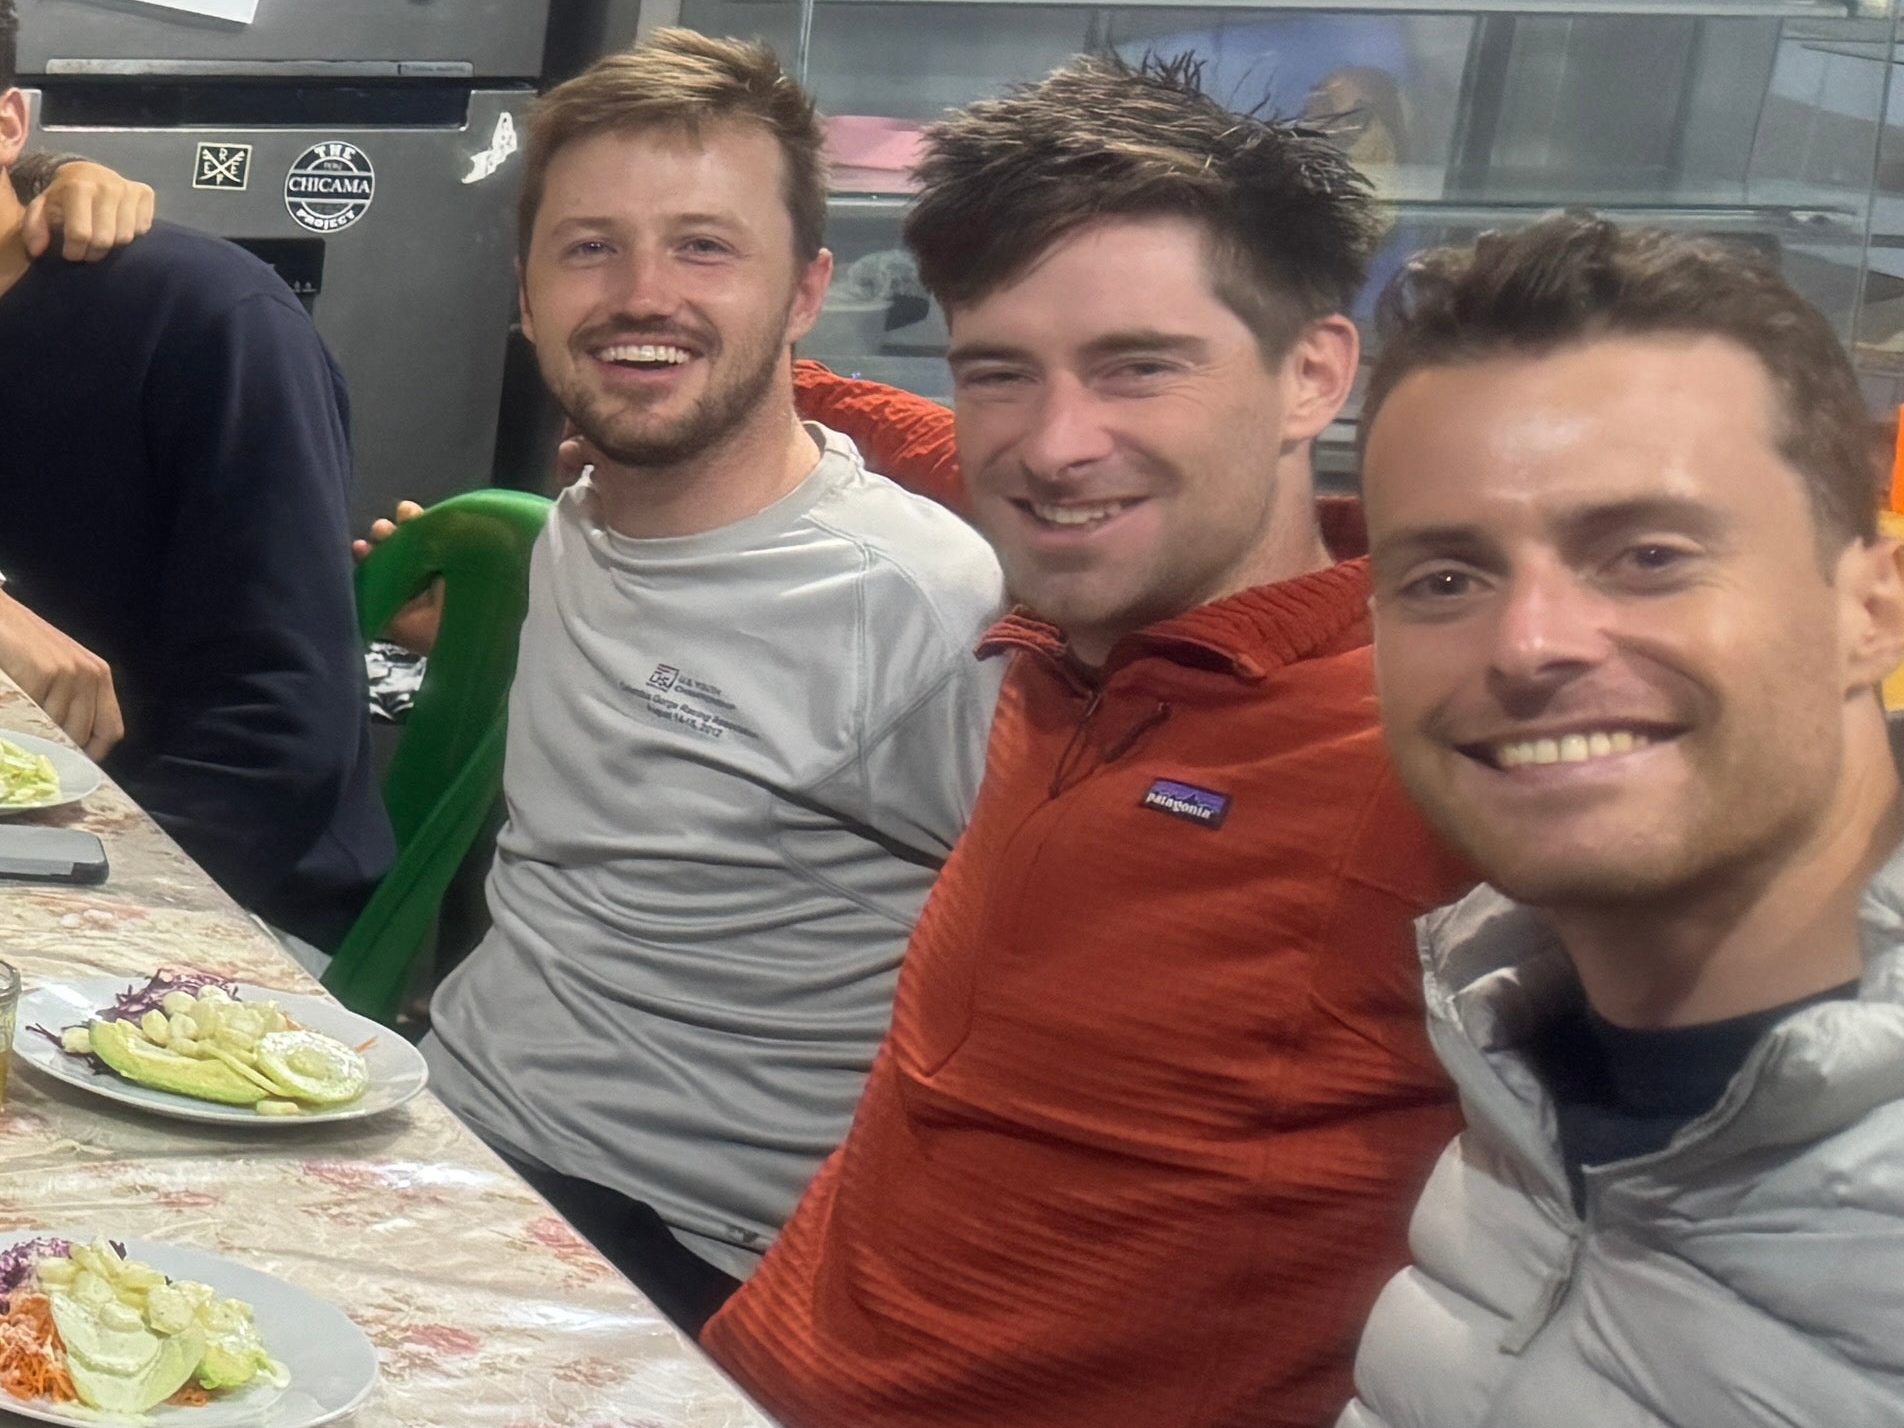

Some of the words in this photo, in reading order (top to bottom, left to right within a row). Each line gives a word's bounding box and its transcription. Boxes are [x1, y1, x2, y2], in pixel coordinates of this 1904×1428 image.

[313, 144, 356, 161] THE
[288, 176, 371, 194] CHICAMA
[295, 208, 356, 230] PROJECT
[1144, 791, 1214, 820] patagonia
